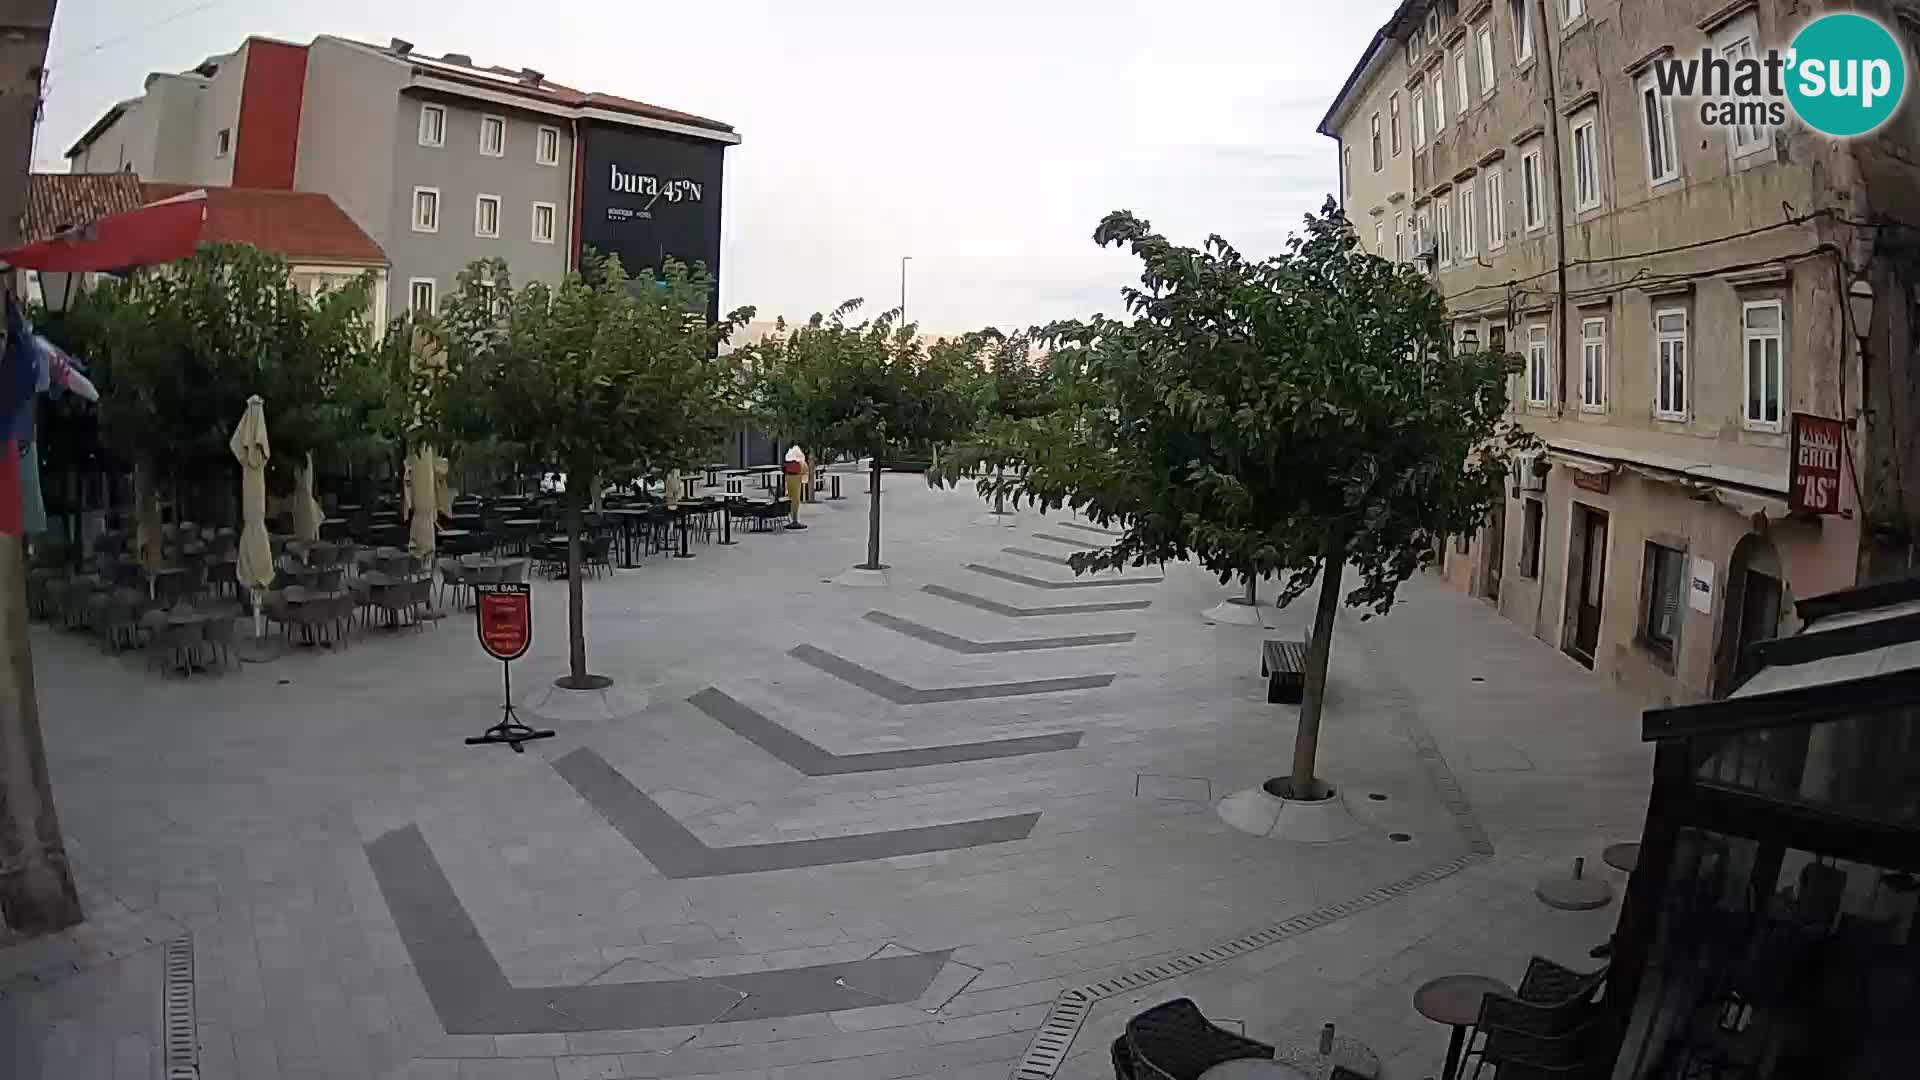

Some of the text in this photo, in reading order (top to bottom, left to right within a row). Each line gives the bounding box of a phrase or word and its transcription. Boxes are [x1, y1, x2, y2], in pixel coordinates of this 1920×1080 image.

[610, 164, 657, 195] bura
[1796, 474, 1837, 509] "AS"
[500, 583, 519, 593] BAR
